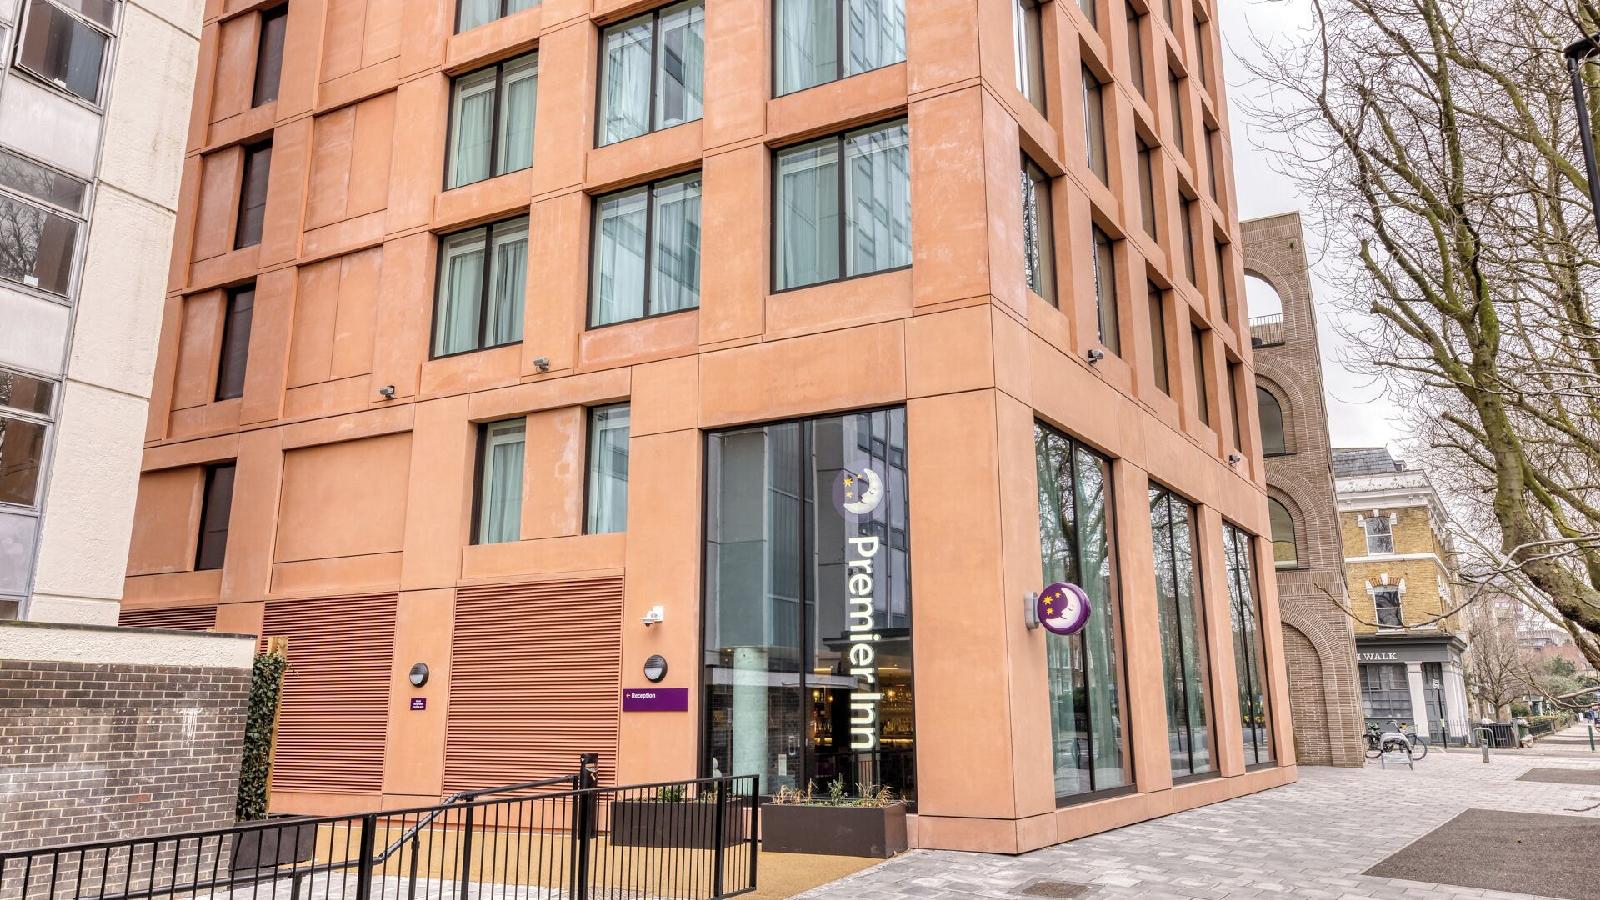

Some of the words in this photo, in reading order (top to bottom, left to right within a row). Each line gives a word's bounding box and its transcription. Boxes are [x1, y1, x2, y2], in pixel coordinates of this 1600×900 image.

[848, 536, 881, 684] Premier
[1363, 652, 1398, 661] WALK
[631, 692, 656, 700] Reception
[850, 692, 881, 749] Inn
